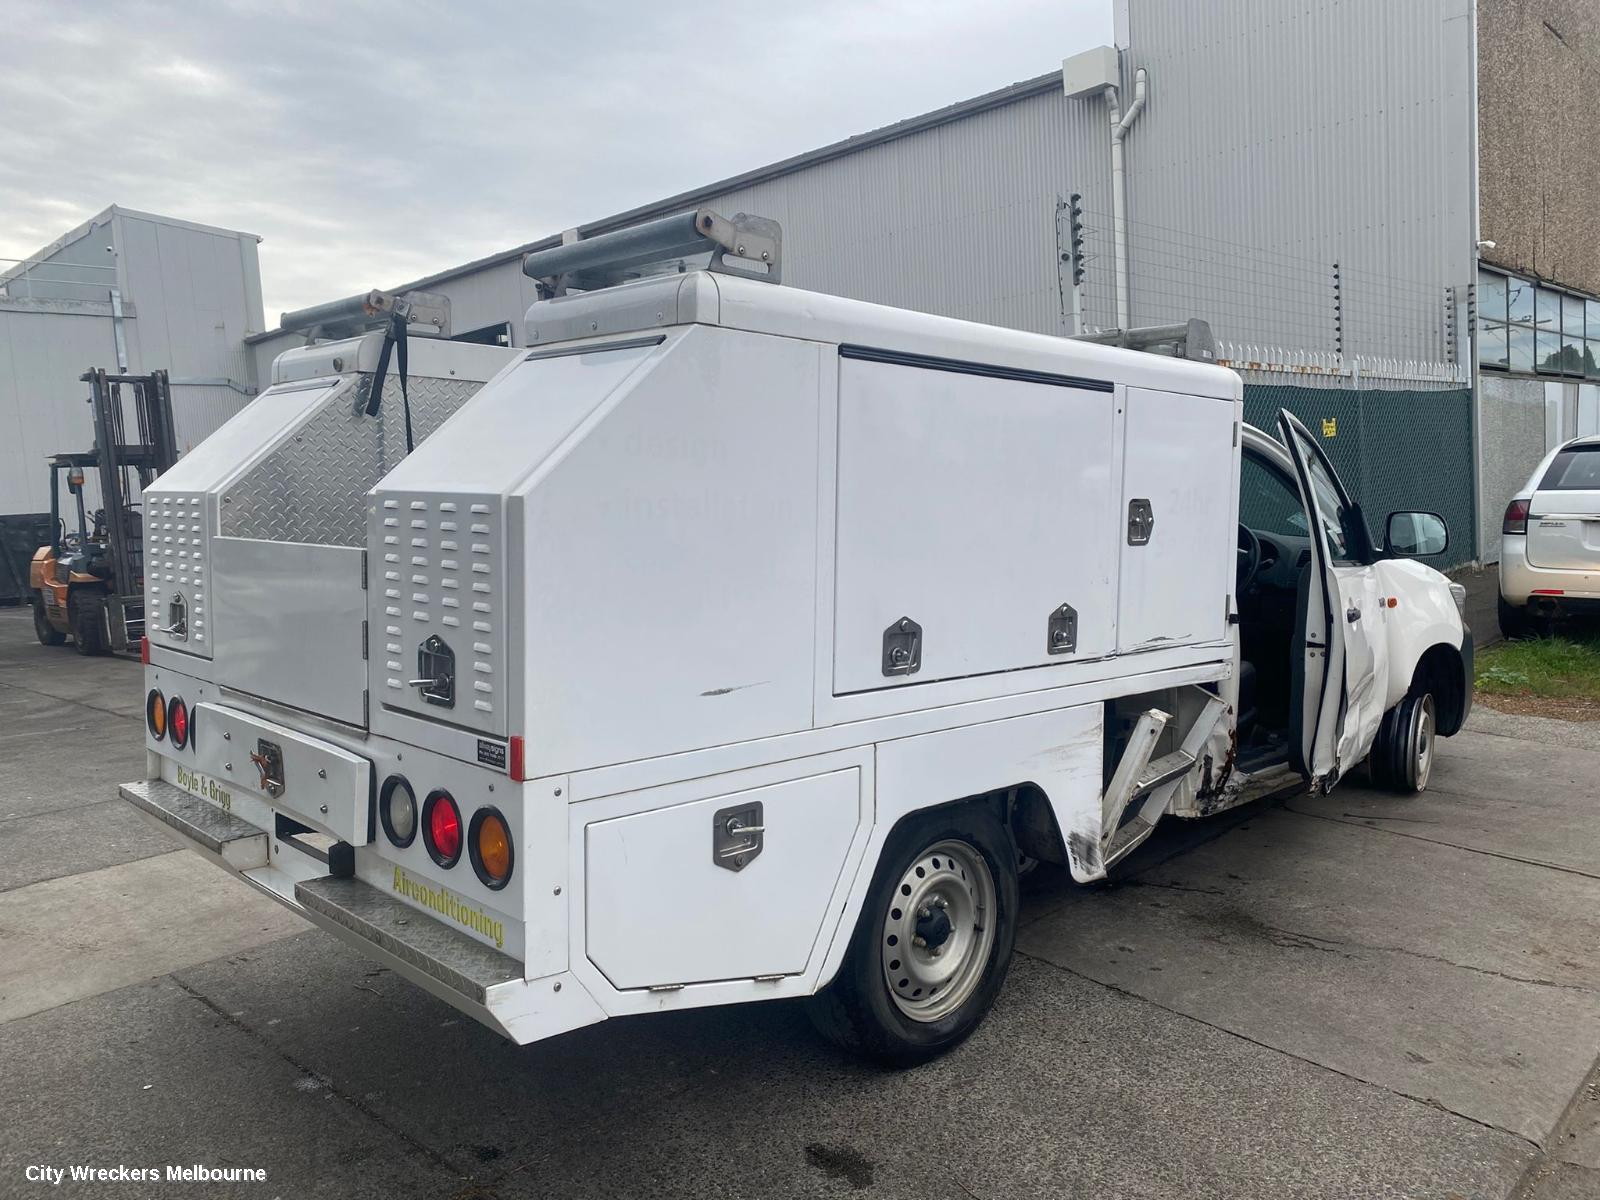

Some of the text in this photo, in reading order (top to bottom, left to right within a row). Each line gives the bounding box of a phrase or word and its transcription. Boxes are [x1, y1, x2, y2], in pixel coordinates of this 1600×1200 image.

[177, 764, 231, 810] Boyle & Grigg
[393, 865, 504, 949] Airconditioning
